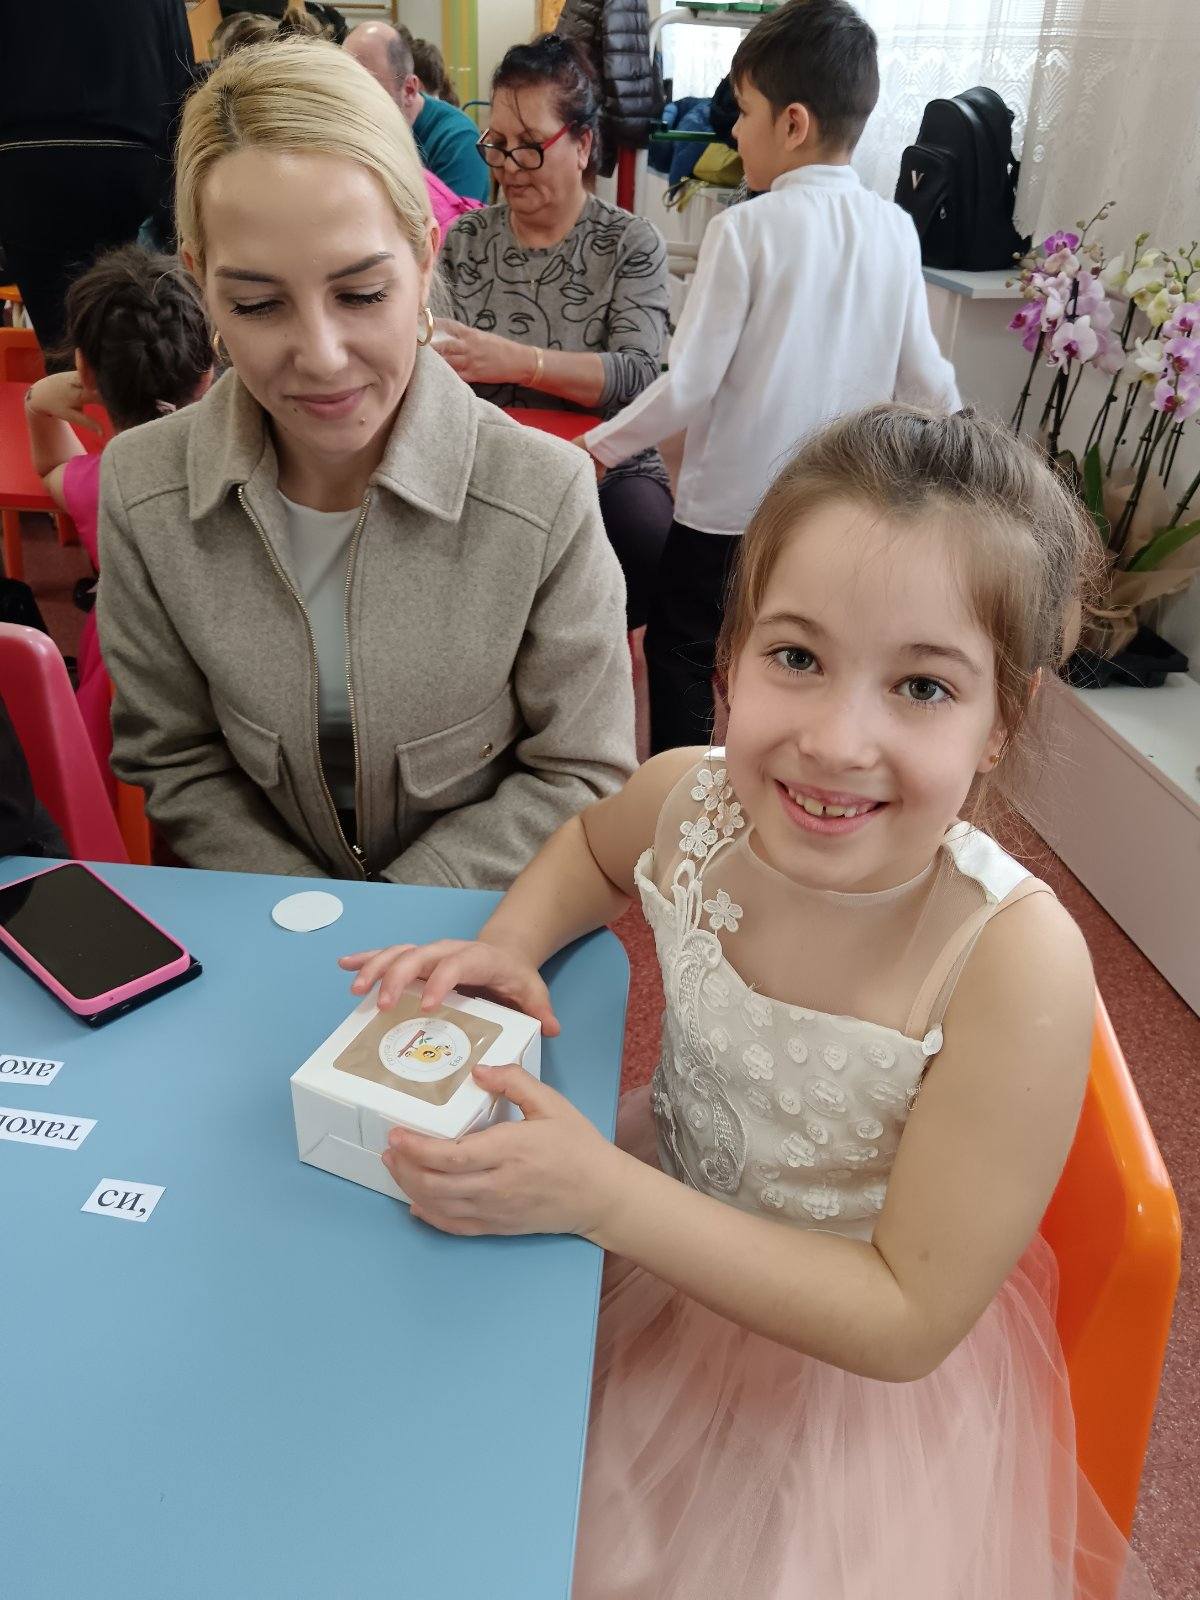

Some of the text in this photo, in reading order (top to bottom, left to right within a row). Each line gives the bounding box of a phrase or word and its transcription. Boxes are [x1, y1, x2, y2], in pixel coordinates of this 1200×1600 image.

[911, 170, 925, 191] V
[0, 1059, 55, 1077] ако
[97, 1189, 147, 1218] си,
